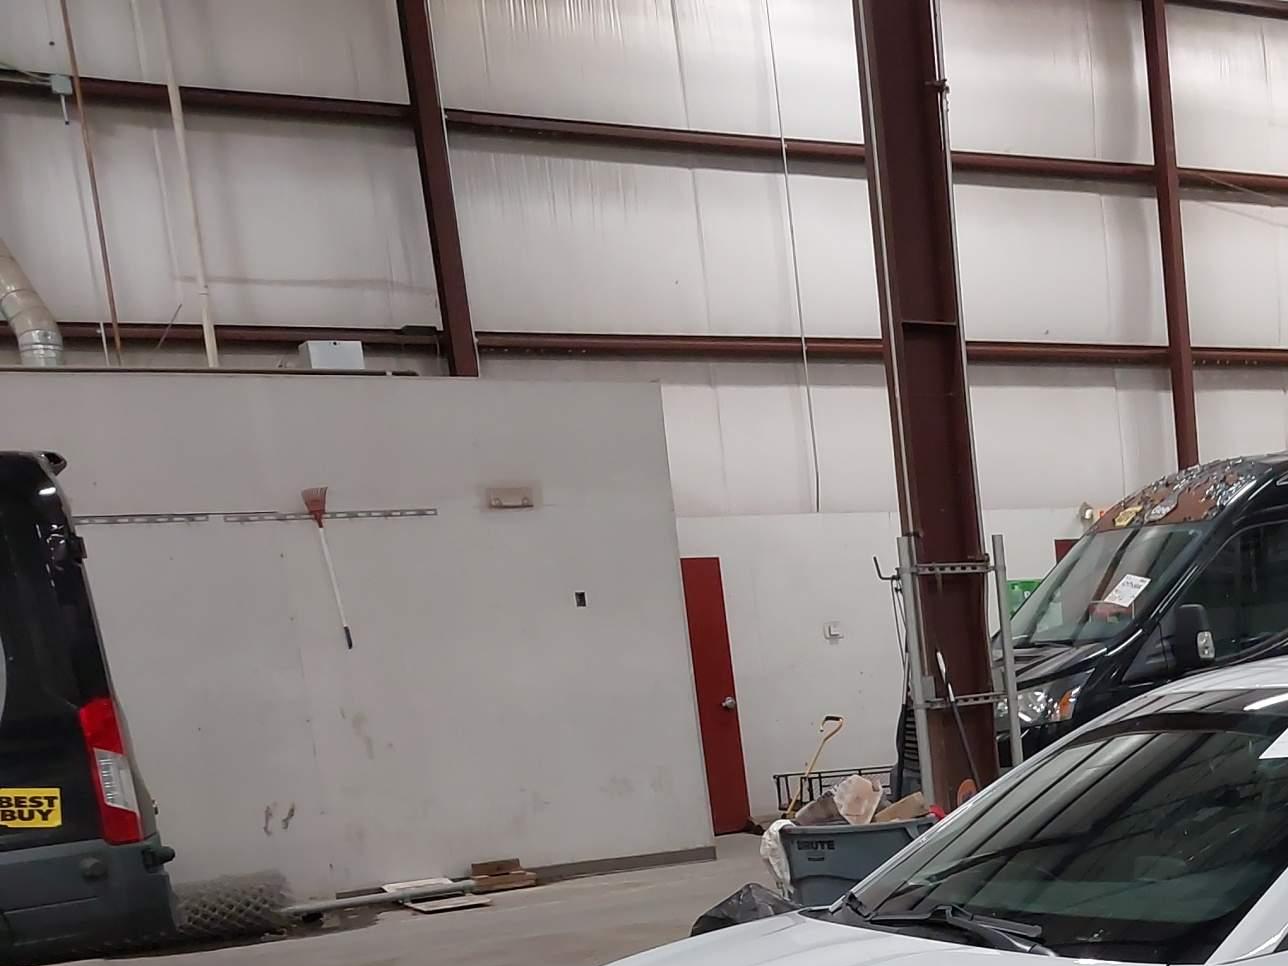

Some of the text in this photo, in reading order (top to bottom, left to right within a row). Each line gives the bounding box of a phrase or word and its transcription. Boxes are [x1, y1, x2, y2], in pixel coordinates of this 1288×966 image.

[0, 796, 58, 808] BEST
[1, 809, 54, 821] BUY
[797, 840, 835, 850] BRUTE
